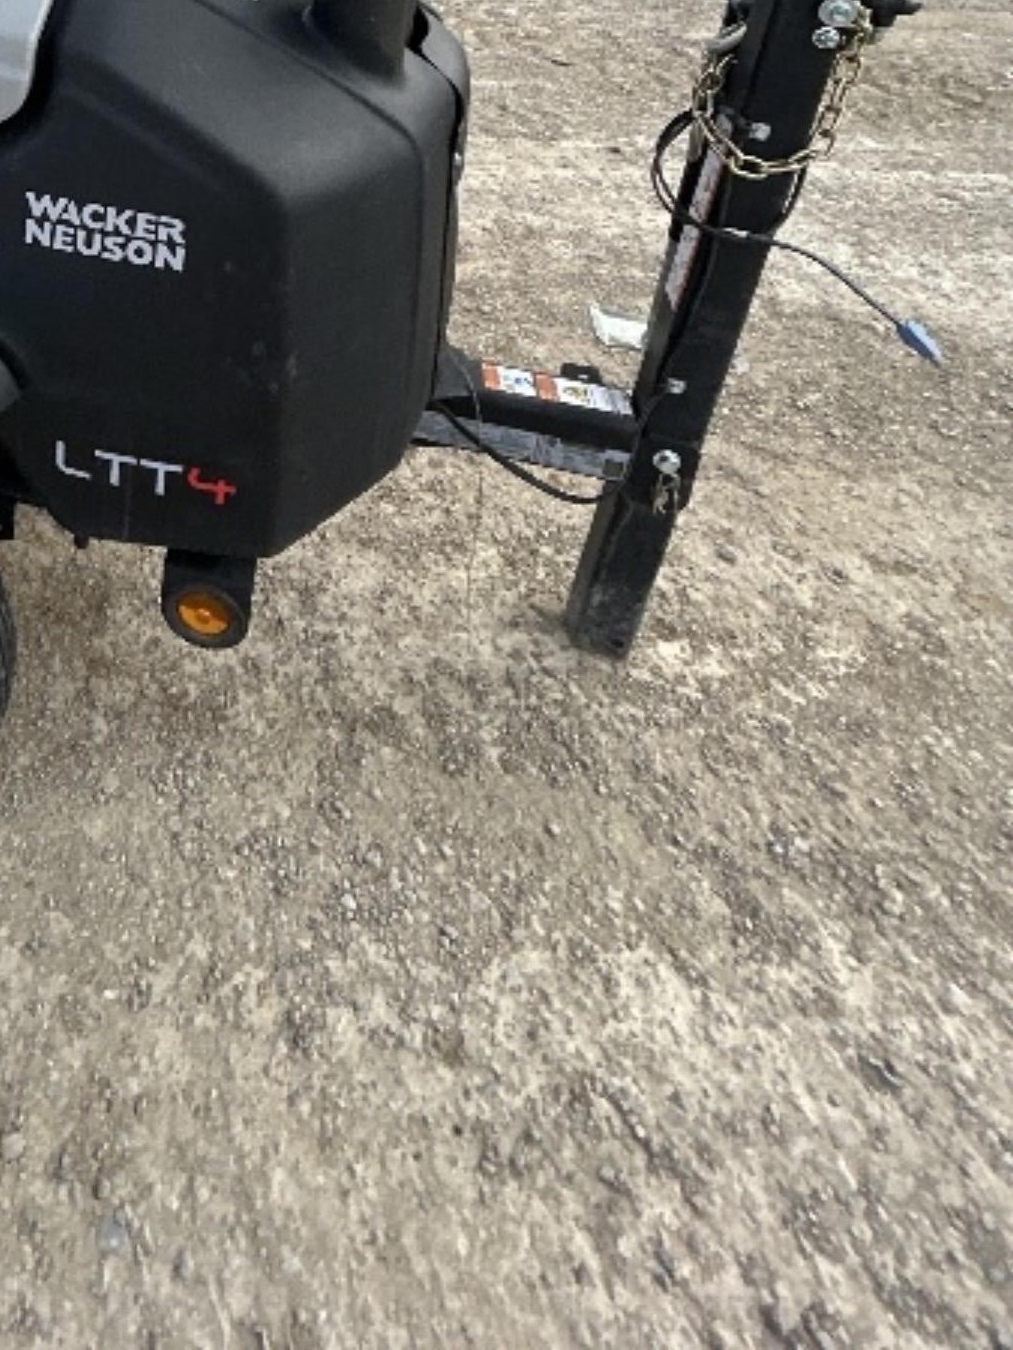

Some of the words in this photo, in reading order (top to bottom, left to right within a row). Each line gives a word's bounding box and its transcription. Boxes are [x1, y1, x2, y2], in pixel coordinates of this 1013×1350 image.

[25, 191, 186, 244] WACKER
[25, 218, 186, 273] NEUSON
[55, 440, 237, 506] LTT4
